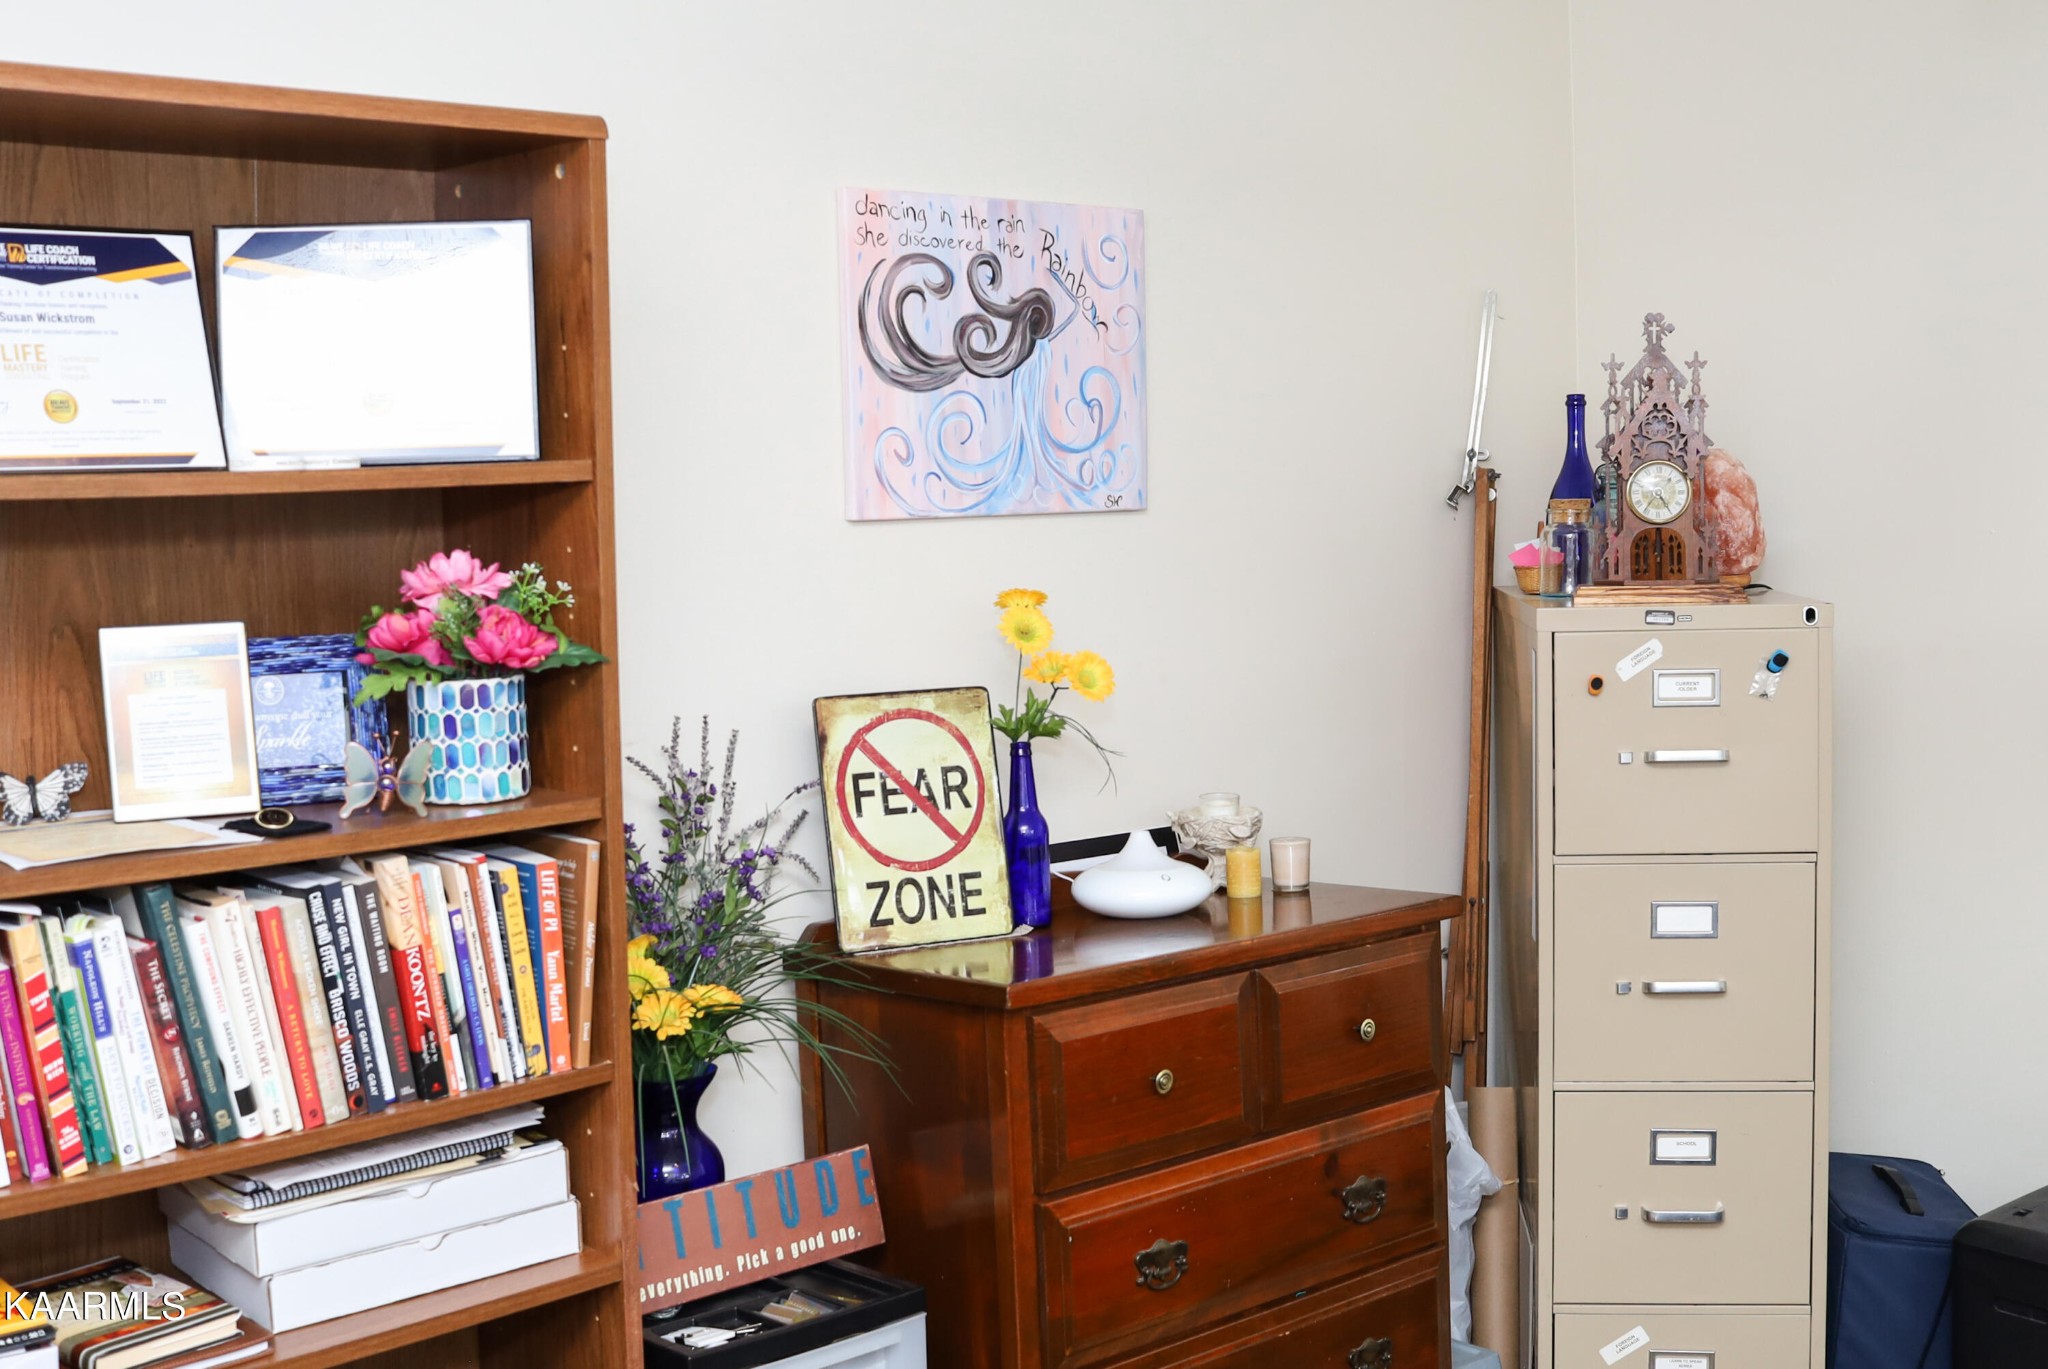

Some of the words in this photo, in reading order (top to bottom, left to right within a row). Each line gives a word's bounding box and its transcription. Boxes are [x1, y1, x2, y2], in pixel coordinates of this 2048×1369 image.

[855, 194, 926, 233] dancing
[940, 206, 953, 226] in
[961, 204, 990, 230] the
[997, 214, 1025, 233] rain
[25, 244, 45, 254] LIFE
[46, 246, 79, 255] COACH
[855, 225, 888, 247] she
[898, 230, 984, 251] discovered
[996, 237, 1024, 259] the
[27, 254, 96, 265] CERTIFICATION
[0, 312, 33, 322] Susan
[36, 312, 95, 324] Wickstrom
[0, 343, 47, 362] LIFE
[1630, 646, 1651, 662] FOREIGN
[852, 765, 972, 818] FEAR
[540, 869, 557, 898] LIFE
[866, 871, 987, 928] ZONE
[159, 901, 172, 923] THE
[307, 891, 326, 924] CAUSE
[331, 897, 344, 924] NEW
[366, 893, 375, 909] THE
[315, 923, 332, 945] AND
[337, 925, 350, 951] GIRL
[368, 911, 382, 947] WAITING
[398, 895, 418, 948] DEAN
[543, 917, 558, 931] PI
[165, 923, 186, 974] CELESTINE
[319, 943, 338, 977] EFFECT
[342, 952, 352, 965] IN
[375, 948, 388, 973] ROOM
[545, 949, 562, 979] Yann
[81, 948, 102, 999] NAPOLEON
[92, 1000, 108, 1032] HILL'S
[147, 958, 161, 981] THE
[154, 981, 172, 1021] SECRET
[345, 966, 359, 1000] TOWN
[403, 946, 432, 1022] KOONTZ
[427, 949, 435, 966] THE
[431, 967, 441, 1006] HUNDRED
[179, 976, 201, 1030] PROPHECY
[213, 986, 224, 1016] EFFECT
[233, 948, 249, 984] HIGHLY
[242, 985, 262, 1040] EFFECTIVE
[255, 1039, 272, 1079] PEOPLE
[388, 1005, 399, 1031] EMILY
[547, 982, 564, 1023] Martel
[288, 1013, 303, 1053] RETURN
[354, 1008, 364, 1029] ELLE
[222, 1021, 234, 1051] DARREN
[231, 1053, 242, 1080] HARDY
[327, 987, 349, 1039] BRISCO
[338, 1039, 359, 1091] WOODS
[358, 1030, 369, 1053] GRAY
[10, 1041, 27, 1089] INFINITE
[66, 1005, 86, 1057] WORKING
[84, 1084, 96, 1107] THE
[90, 1108, 102, 1131] LAW
[136, 1030, 149, 1059] POWER
[147, 1077, 165, 1120] DECISION
[297, 1055, 307, 1070] TO
[301, 1072, 313, 1101] LOVE
[367, 1073, 377, 1096] GRAY
[637, 1149, 876, 1270] TITUDE
[640, 1264, 730, 1302] everything.
[737, 1249, 769, 1273] Pick
[775, 1246, 785, 1261] a
[790, 1232, 825, 1259] good
[831, 1225, 861, 1244] one.
